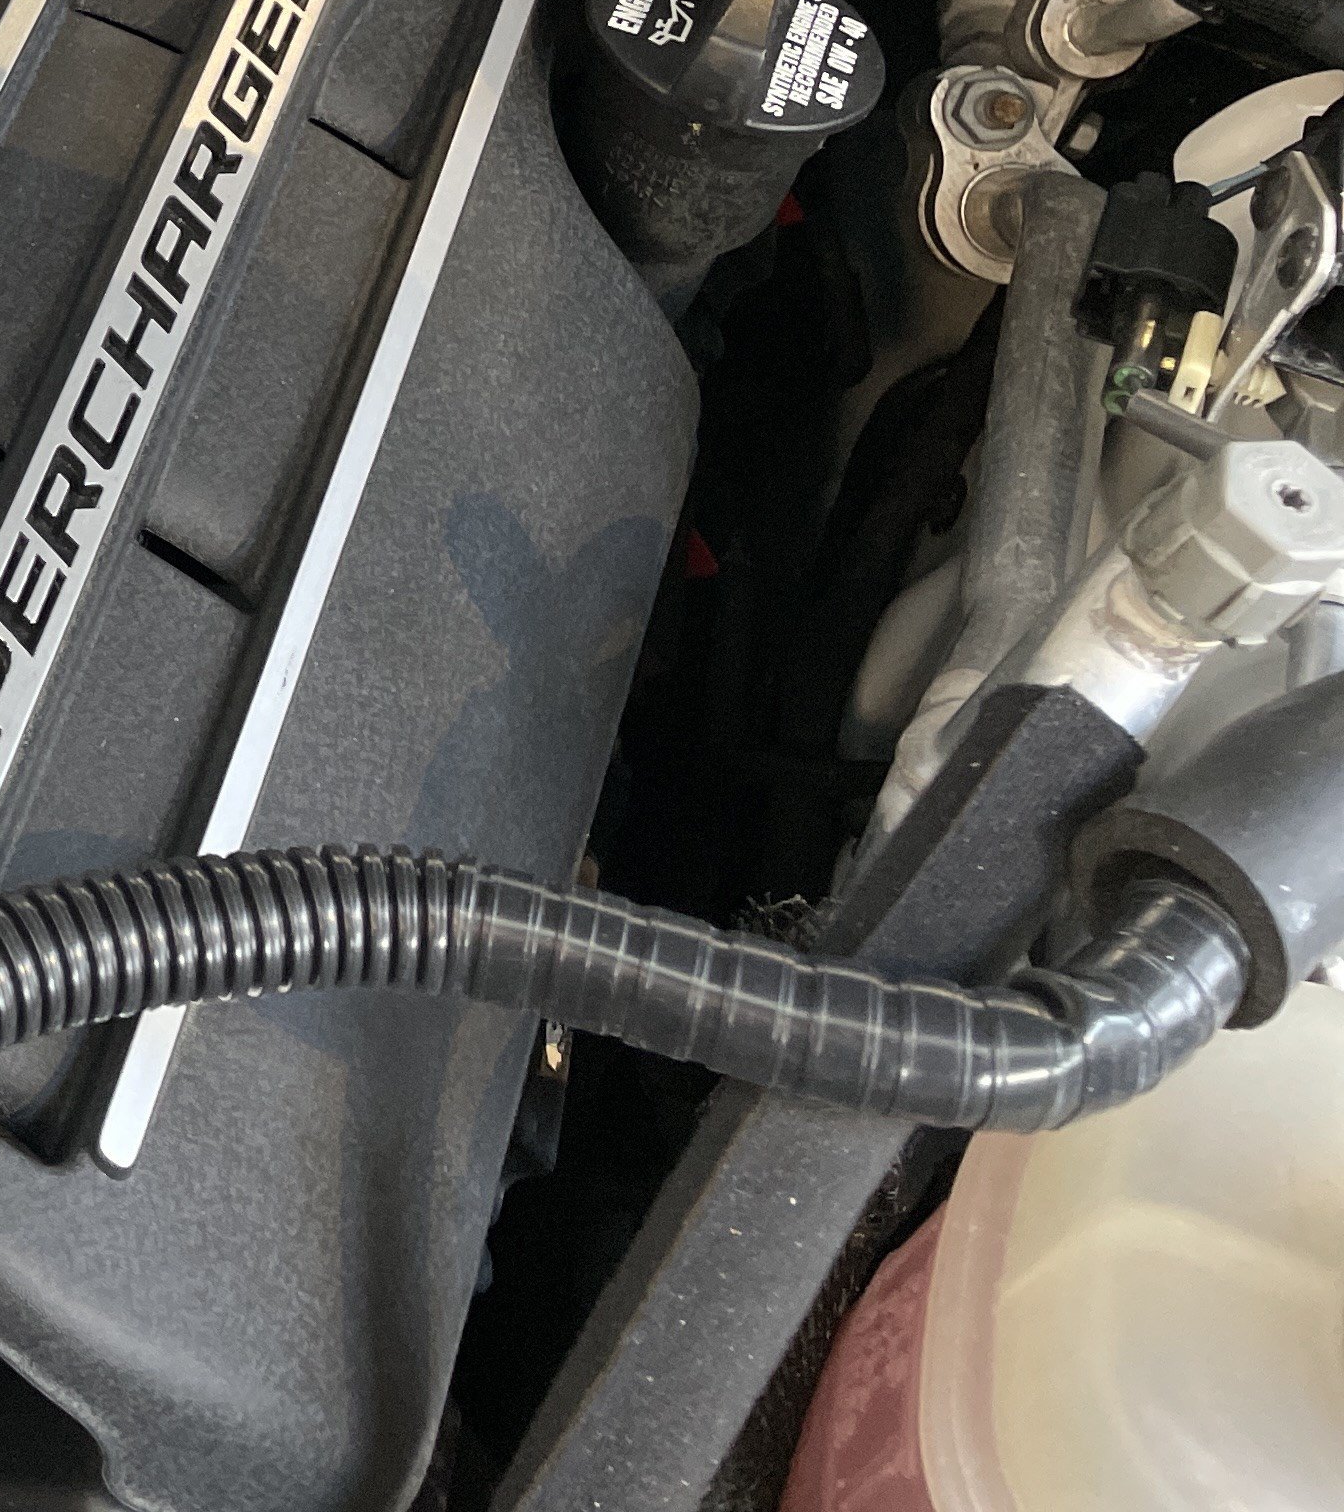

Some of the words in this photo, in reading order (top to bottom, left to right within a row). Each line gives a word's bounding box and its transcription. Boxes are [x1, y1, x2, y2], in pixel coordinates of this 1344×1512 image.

[761, 41, 803, 117] SYNTHETIC
[788, 2, 839, 107] RECOMMENDED
[815, 71, 849, 110] SAE
